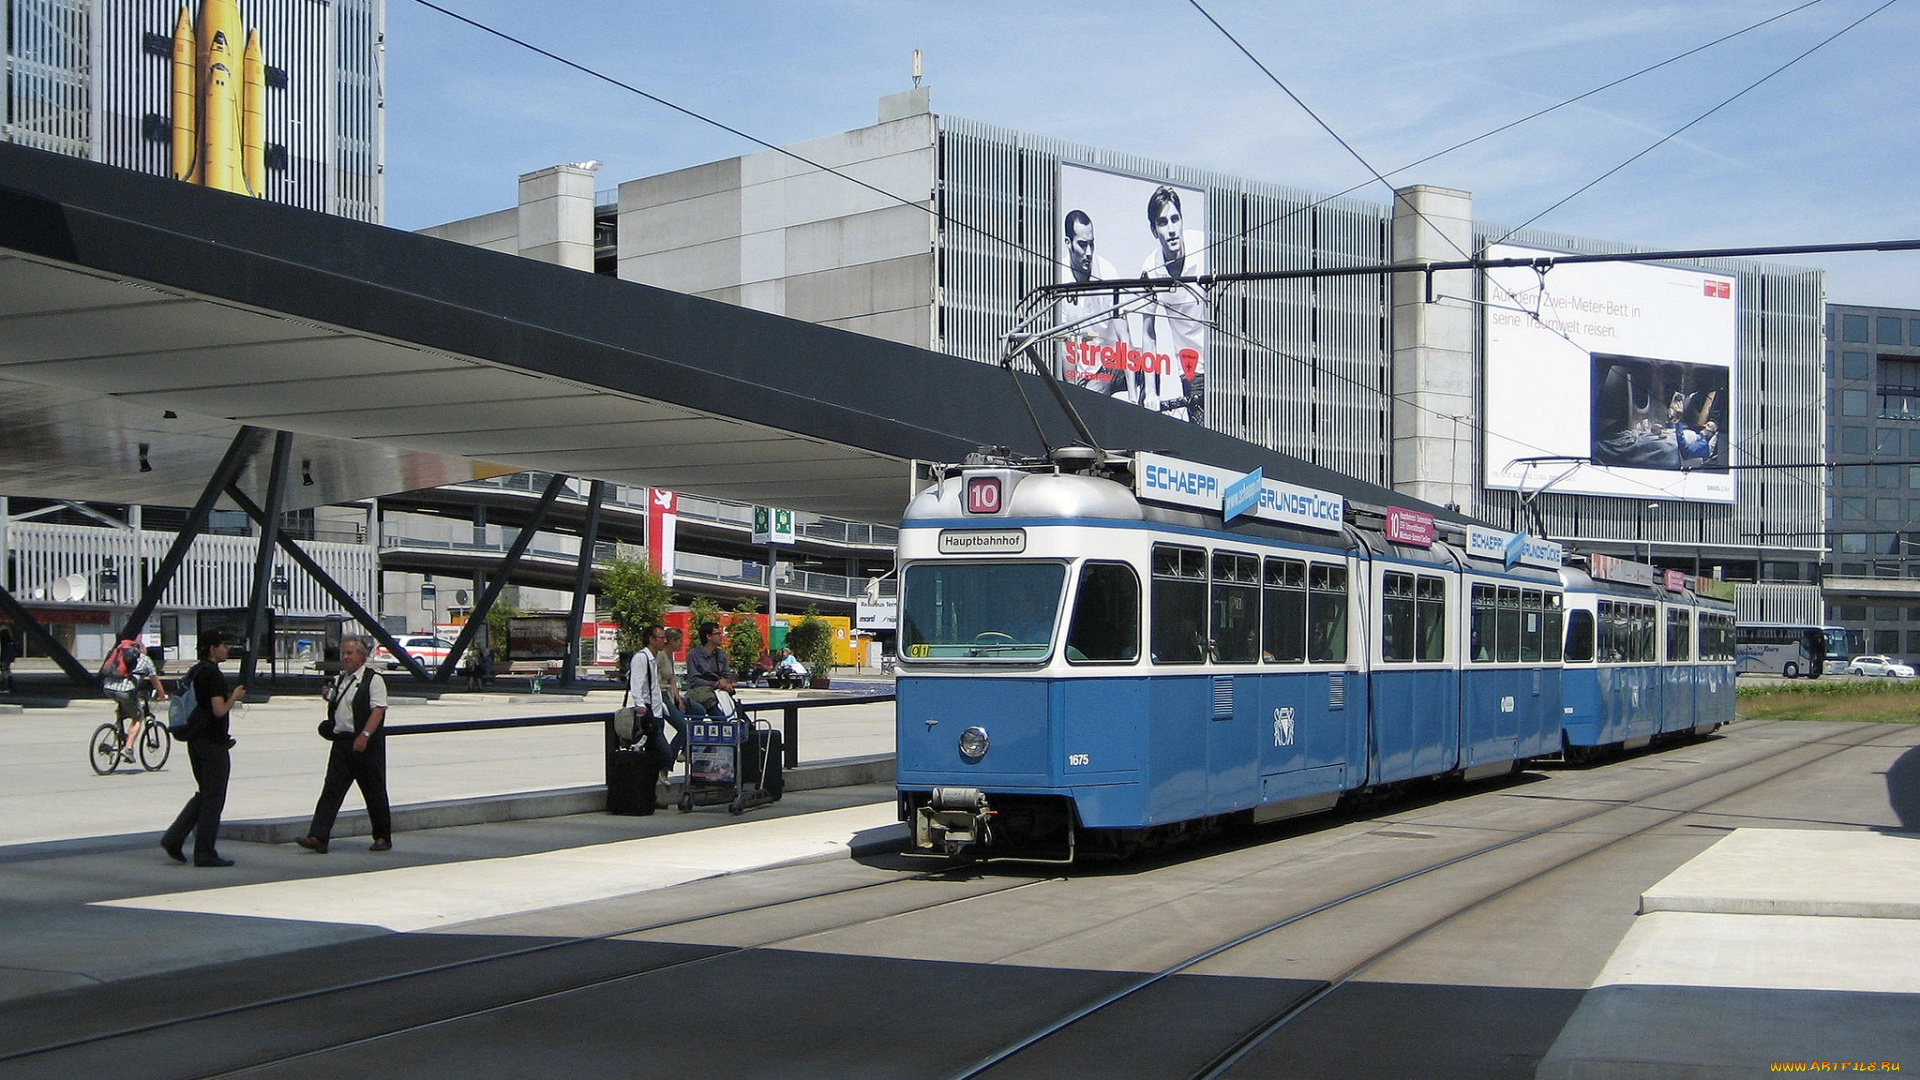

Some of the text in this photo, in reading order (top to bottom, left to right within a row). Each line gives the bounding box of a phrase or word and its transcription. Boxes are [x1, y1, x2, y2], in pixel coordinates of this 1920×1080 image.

[1543, 291, 1630, 317] Zwei-Meter-Bett
[1631, 304, 1642, 318] in
[1492, 312, 1521, 327] seine
[1525, 314, 1581, 334] Traumwelt
[1065, 341, 1171, 375] strellson
[1145, 464, 1219, 499] SCHAEPPI
[971, 484, 998, 508] 10
[1258, 487, 1340, 522] GRUNDSTÜCKE
[1390, 512, 1399, 538] 10
[945, 534, 1021, 548] Hauptbahnhof
[1471, 532, 1504, 552] SCHAEPPI
[1068, 753, 1090, 766] 1675
